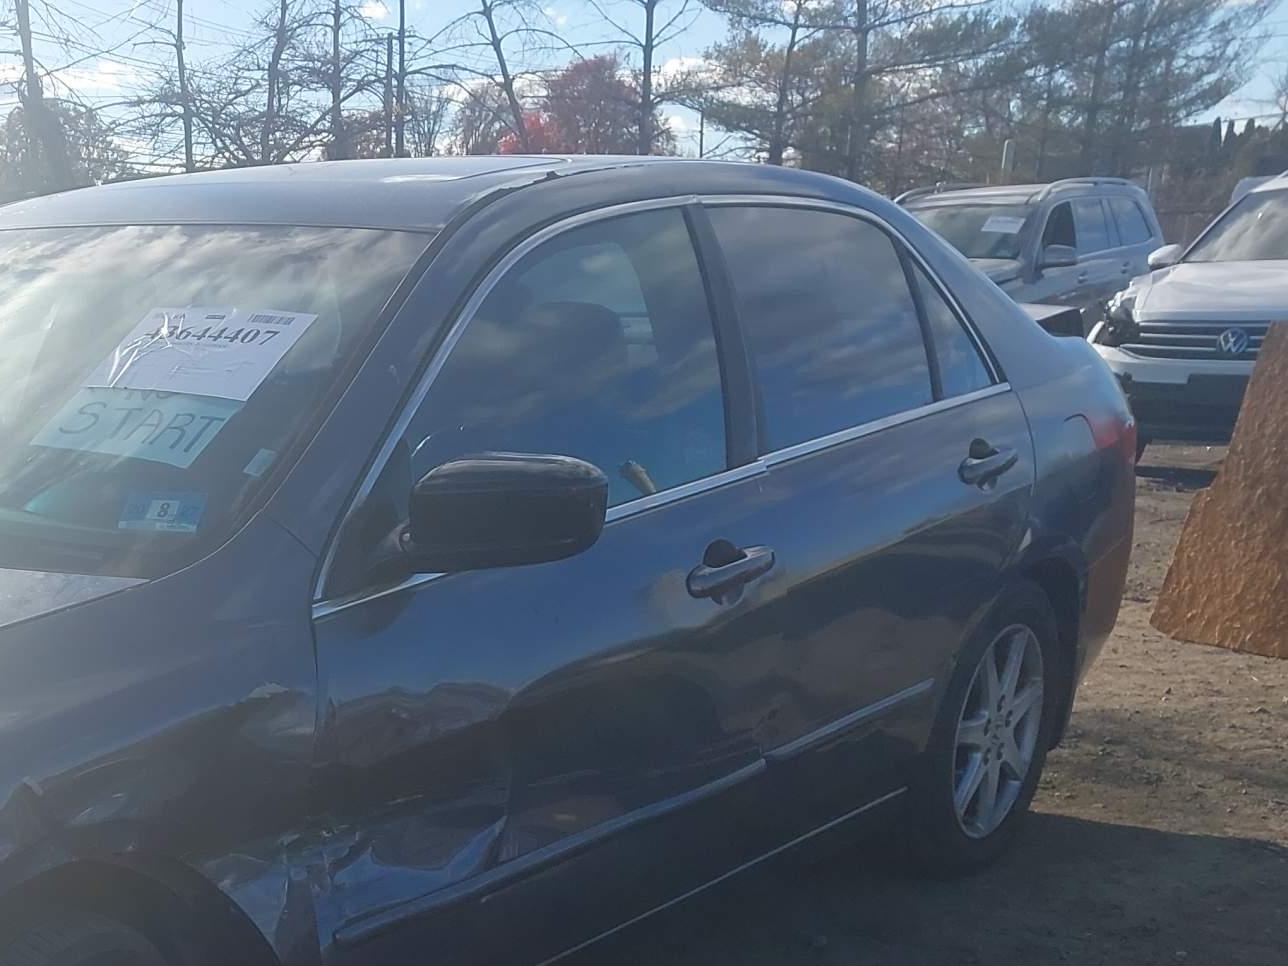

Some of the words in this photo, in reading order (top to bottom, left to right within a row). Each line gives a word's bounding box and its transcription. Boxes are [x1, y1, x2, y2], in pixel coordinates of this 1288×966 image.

[144, 324, 281, 346] 43644407
[58, 401, 226, 453] START
[157, 502, 170, 518] 8
